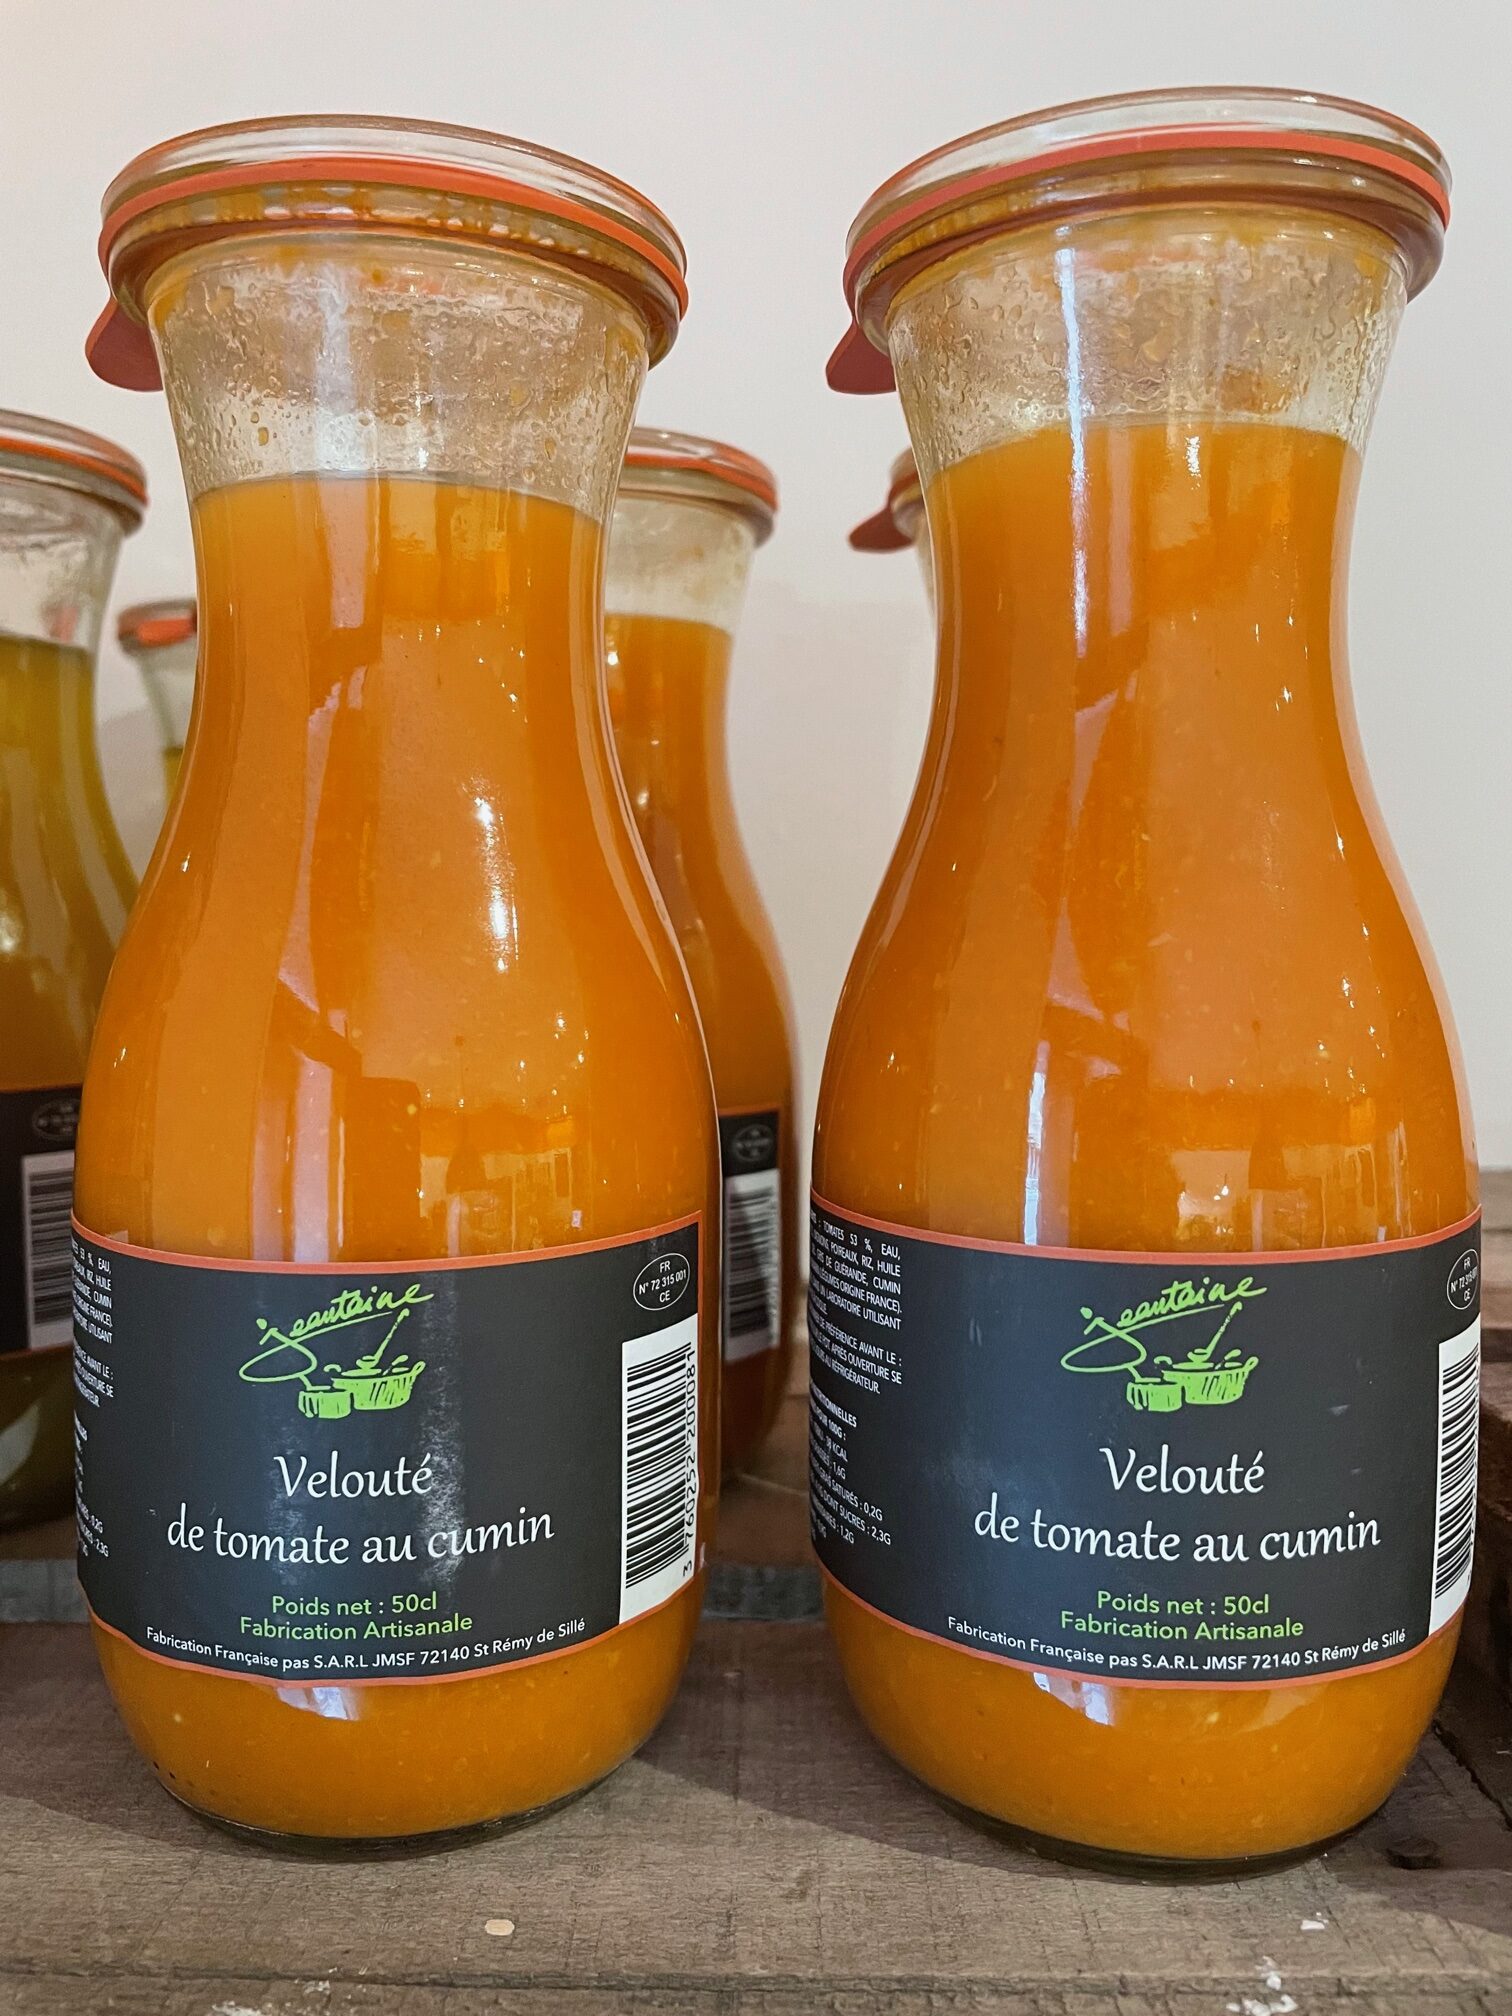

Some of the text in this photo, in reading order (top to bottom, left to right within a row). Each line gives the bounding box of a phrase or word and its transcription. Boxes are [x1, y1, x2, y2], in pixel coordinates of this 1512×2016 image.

[823, 1220, 845, 1241] TOMATES
[850, 1233, 858, 1246] 53
[881, 1243, 901, 1260] EAU,
[831, 1242, 859, 1266] POIREAUX,
[862, 1255, 874, 1271] RIZ,
[877, 1260, 901, 1277] HUILE
[95, 1275, 112, 1292] HUILE
[639, 1269, 687, 1295] N° 72 315 001
[660, 1260, 671, 1273] FR
[826, 1255, 833, 1268] DE
[834, 1259, 869, 1287] GUÉRANDE,
[873, 1276, 901, 1295] CUMIN
[659, 1290, 670, 1303] CE
[826, 1288, 862, 1318] LABORATOIRE
[863, 1308, 902, 1331] UTILISANT
[840, 1280, 866, 1300] ORIGINE
[866, 1292, 903, 1315] FRANCE).
[825, 1320, 857, 1349] PRÉFÉRENCE
[859, 1342, 884, 1361] AVANT
[886, 1351, 897, 1366] LE
[102, 1364, 110, 1379] LE
[831, 1343, 848, 1362] APRÈS
[848, 1353, 890, 1380] OUVERTURE
[891, 1370, 902, 1385] SE
[105, 1383, 114, 1398] SE
[686, 1349, 697, 1443] 200081
[832, 1440, 848, 1462] KCAL
[1100, 1444, 1265, 1495] Velouté
[273, 1450, 433, 1499] Velouté
[685, 1454, 697, 1548] 760252
[832, 1477, 859, 1508] SATURÉS
[864, 1502, 883, 1522] 0,2G
[167, 1502, 555, 1565] de tomate au cumin
[839, 1504, 866, 1532] SUCRES
[871, 1526, 891, 1546] 2,3G
[974, 1492, 1381, 1562] de tomate au cumin
[272, 1591, 437, 1616] Poids net : 50cl
[1097, 1590, 1269, 1616] Poids net : 50cl
[146, 1617, 586, 1672] Fabrication Française pas S.A.R.L JMSF 72140 St Rémy de Sillé
[240, 1613, 473, 1641] Fabrication Artisanale
[948, 1616, 1406, 1670] Fabrication Française pas S.A.R.L JMSF 72140 St Rémy de Sillé
[1060, 1610, 1304, 1641] Fabrication Artisanale
